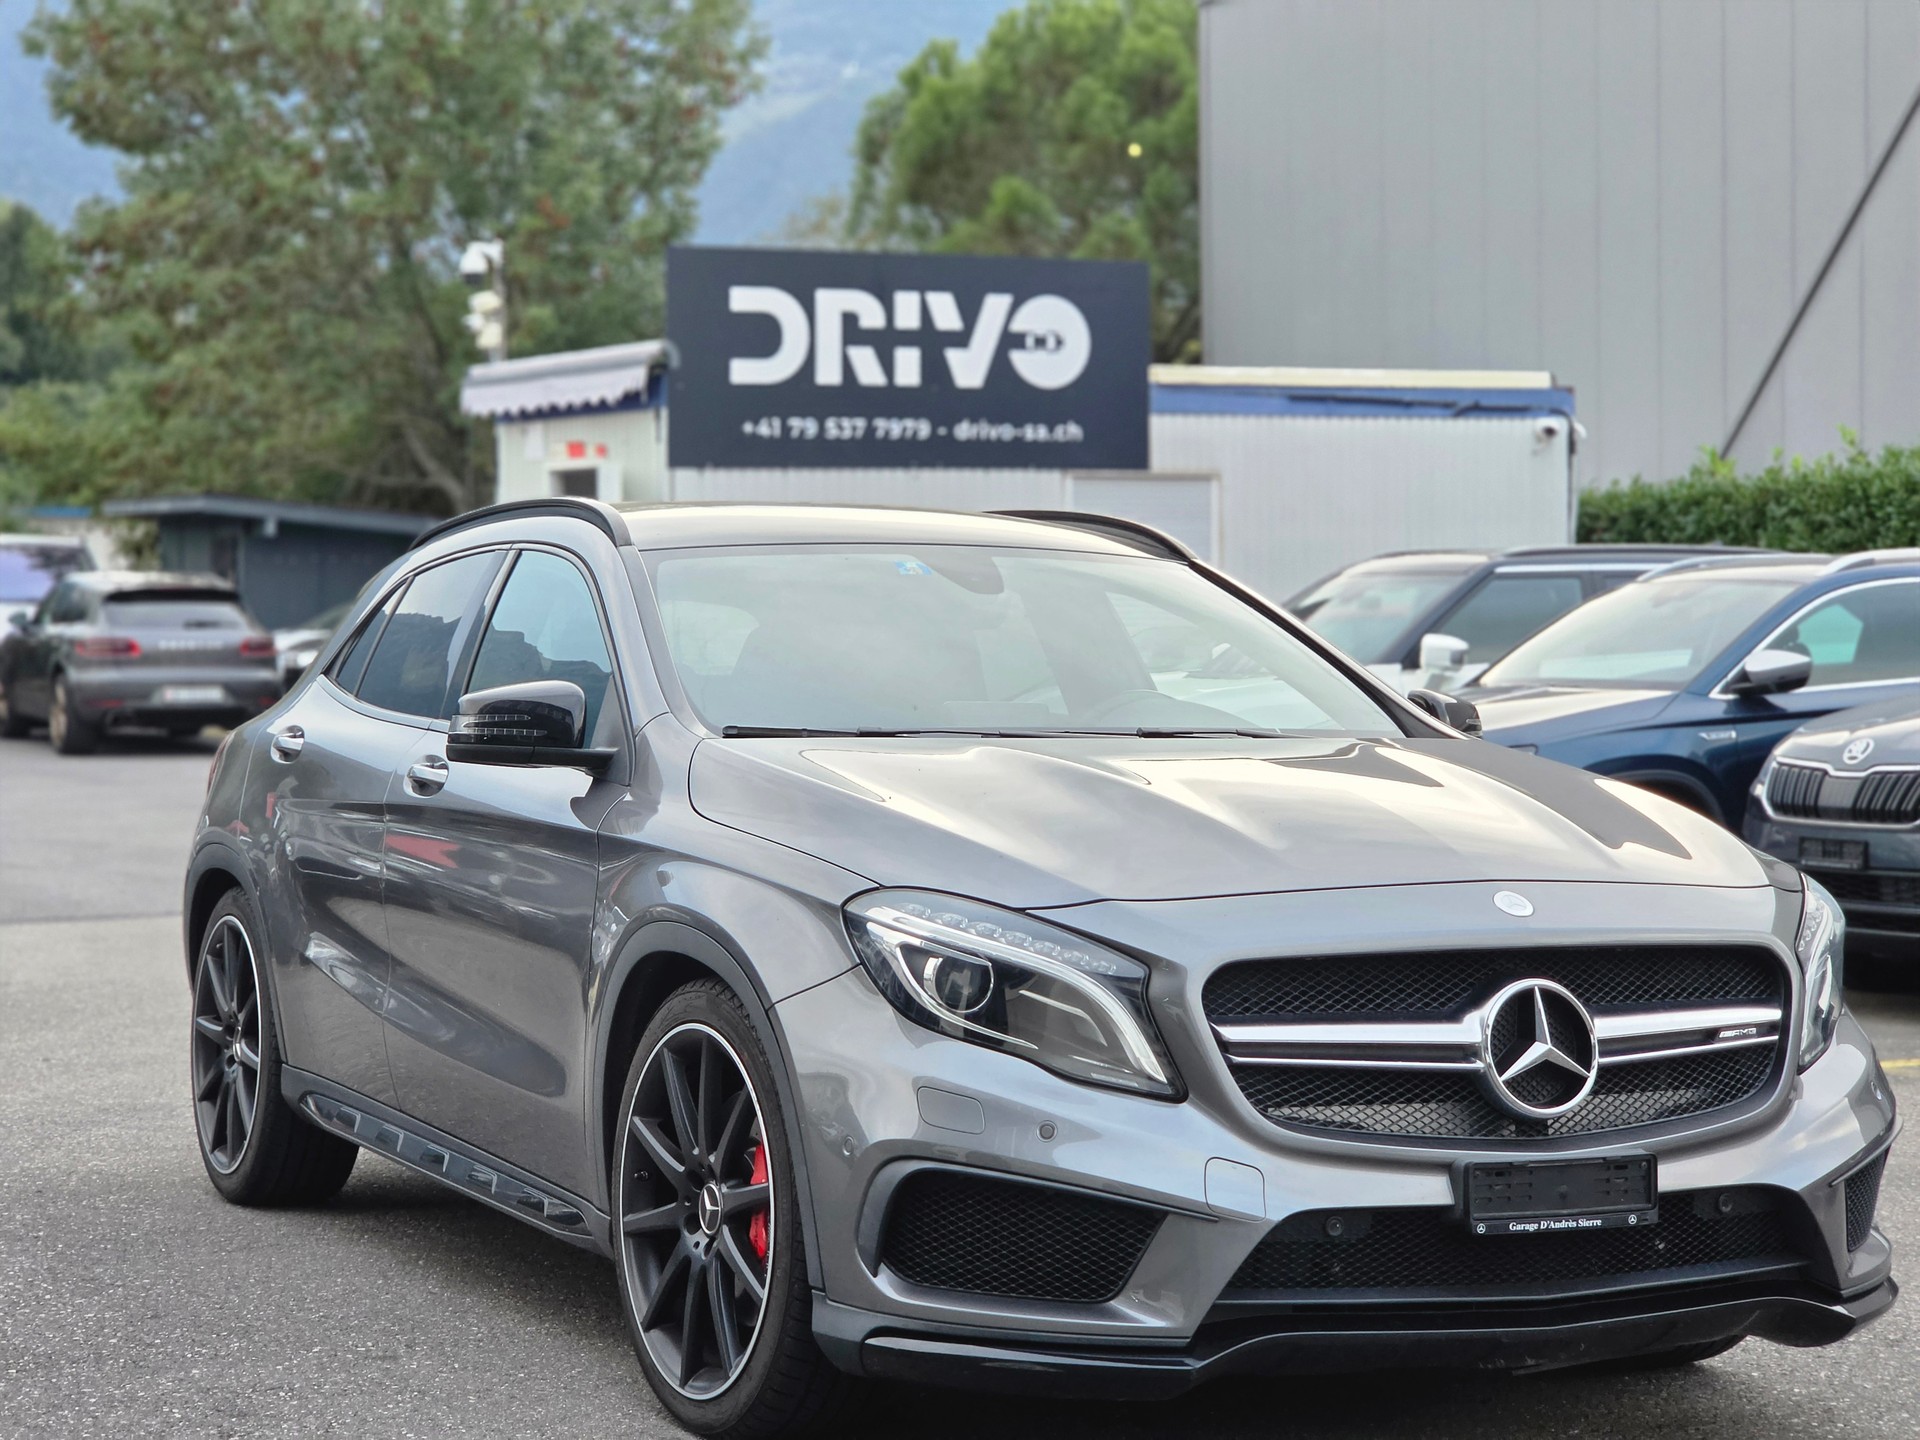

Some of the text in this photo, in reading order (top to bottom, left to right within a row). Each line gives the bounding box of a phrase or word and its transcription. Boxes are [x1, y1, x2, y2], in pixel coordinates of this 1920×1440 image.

[728, 285, 1093, 391] DRIVO
[742, 416, 783, 439] +41
[786, 416, 820, 440] 79
[824, 416, 868, 441] 537
[872, 417, 932, 442] 7979
[953, 418, 1085, 443] drivo-sa.ch
[1729, 1027, 1757, 1037] AMG
[1509, 1222, 1538, 1231] Garage
[1578, 1218, 1602, 1227] Sierre
